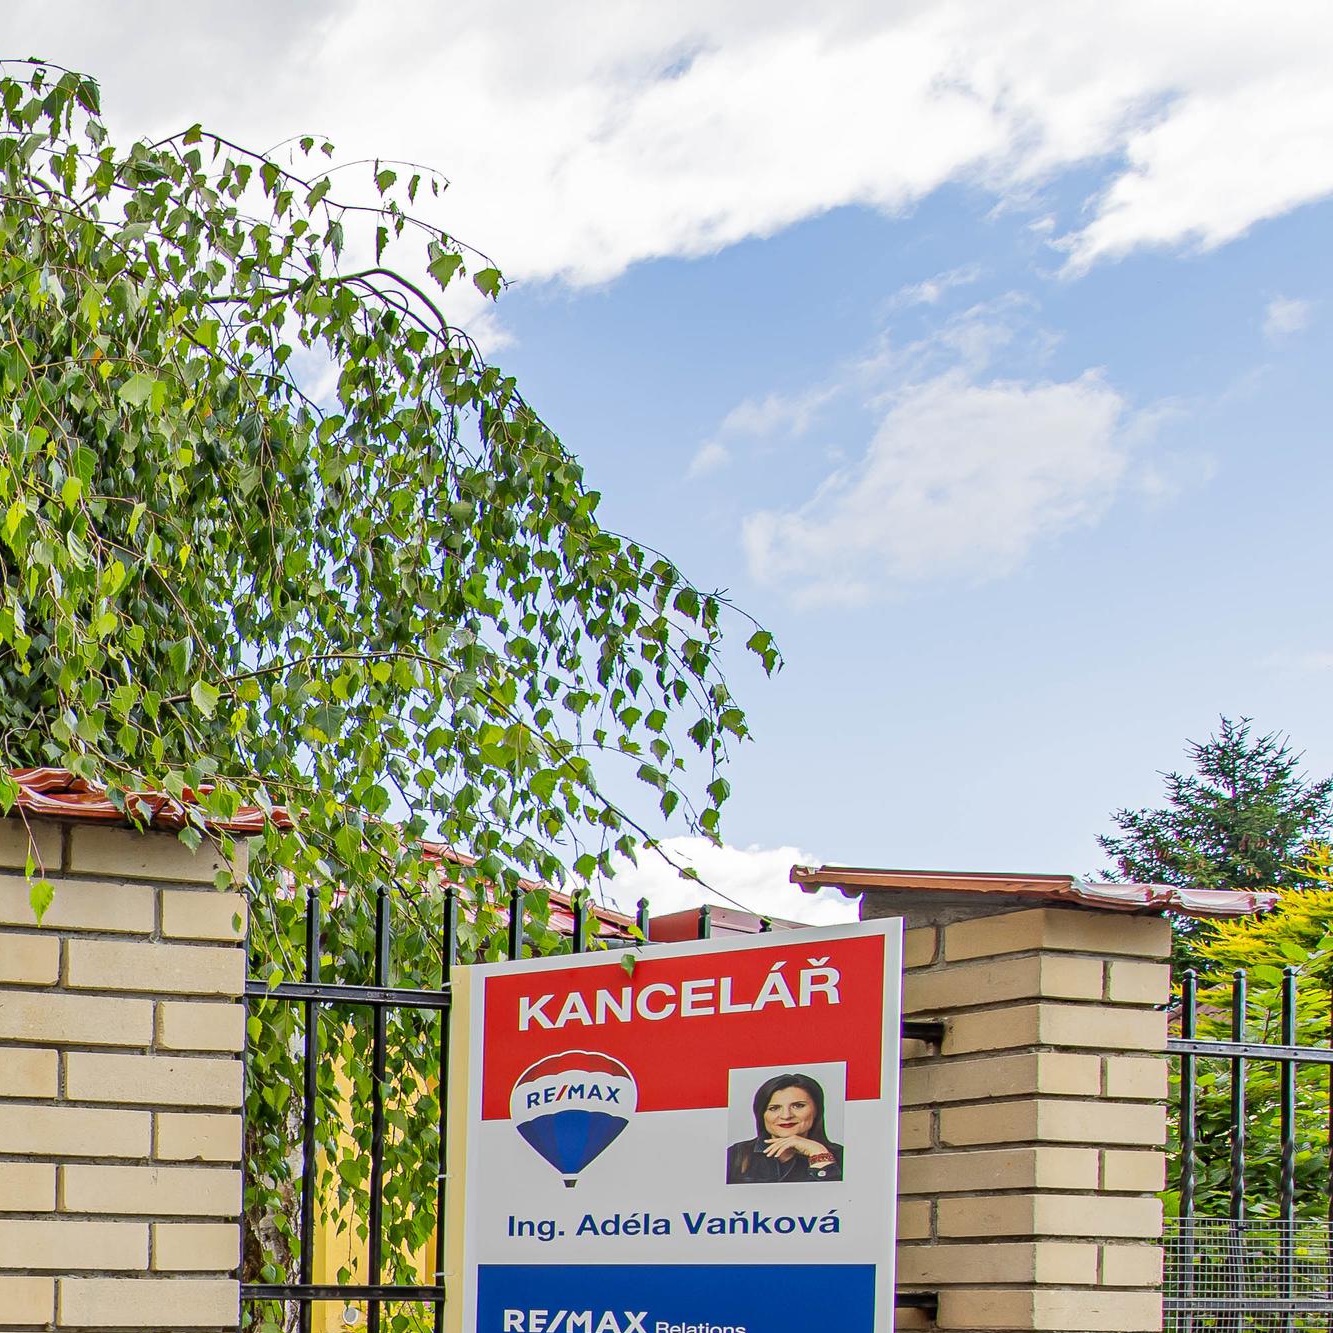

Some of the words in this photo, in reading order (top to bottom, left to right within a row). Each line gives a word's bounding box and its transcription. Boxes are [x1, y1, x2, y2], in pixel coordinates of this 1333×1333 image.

[518, 956, 841, 1031] KANCELÁŘ
[526, 1082, 621, 1110] RE/MAX
[507, 1214, 566, 1241] Ing.
[576, 1211, 671, 1236] Adéla
[682, 1209, 841, 1236] Vaňková
